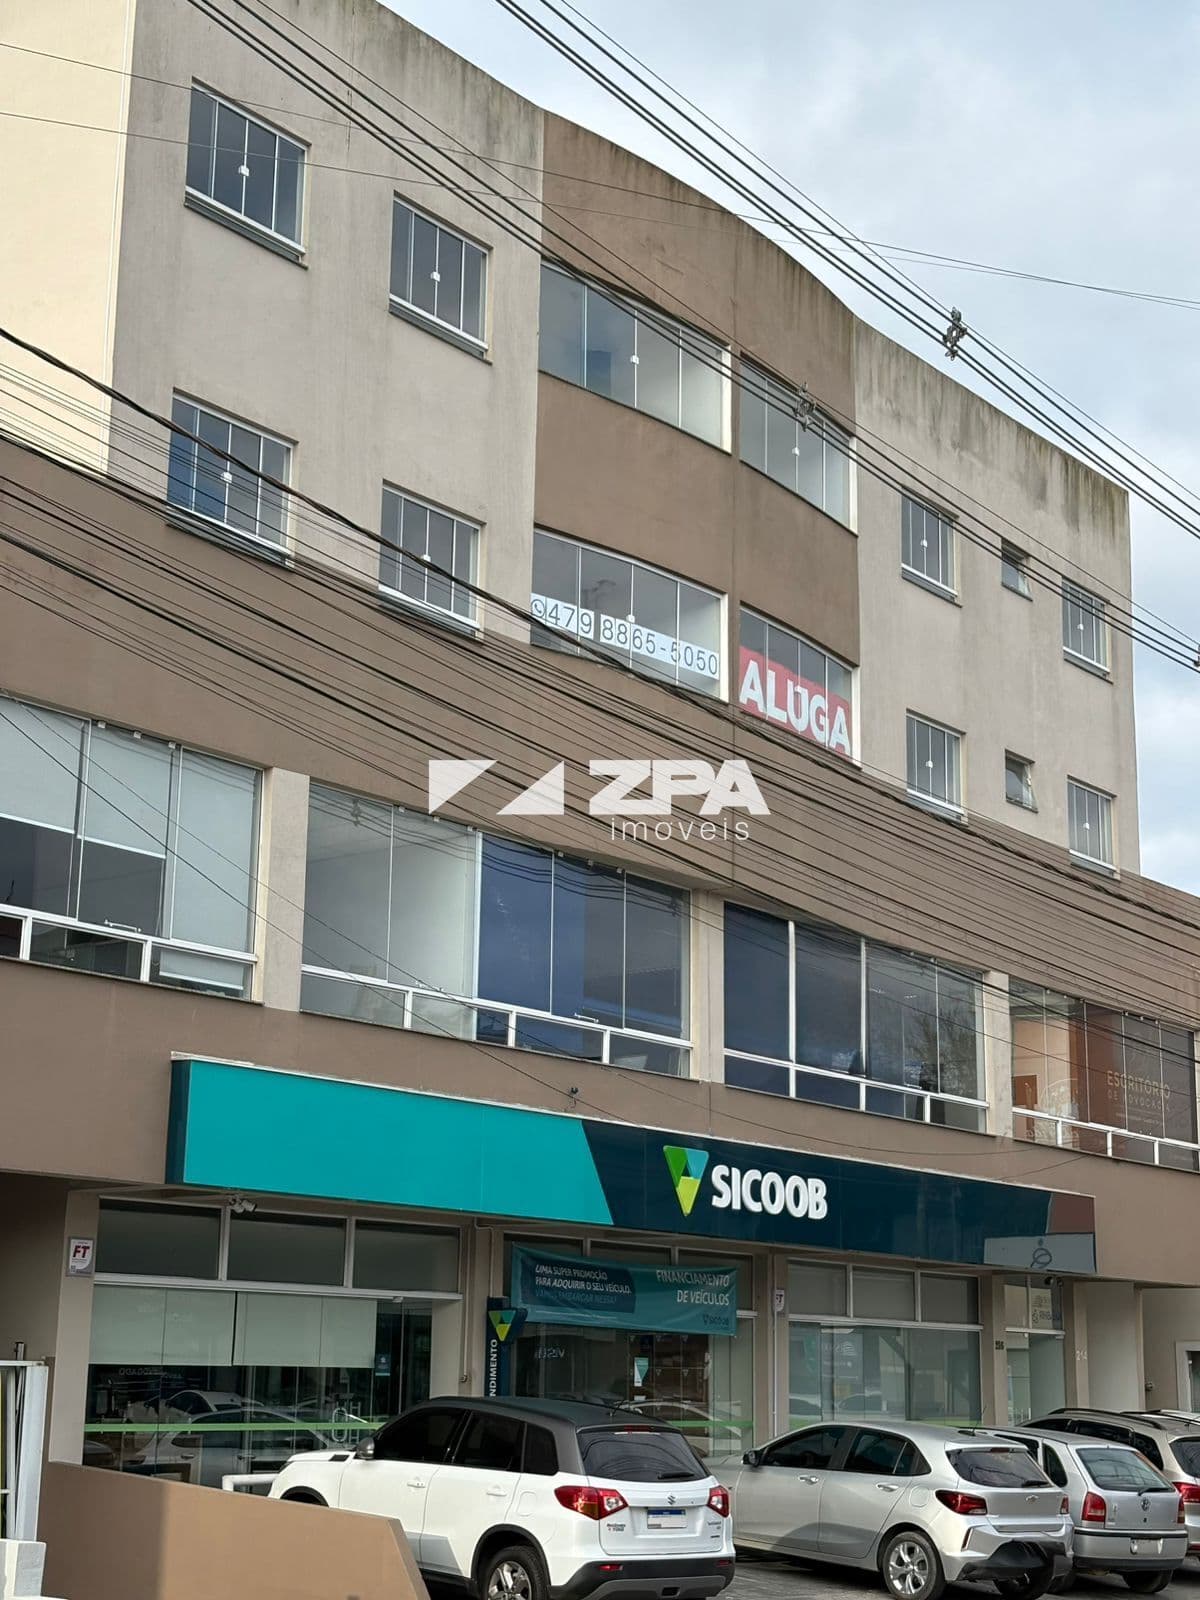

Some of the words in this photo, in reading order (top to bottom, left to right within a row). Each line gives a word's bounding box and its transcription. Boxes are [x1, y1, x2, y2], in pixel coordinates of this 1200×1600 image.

[602, 617, 718, 677] 8865-5050
[740, 659, 852, 756] ALUGA
[711, 1163, 829, 1221] SICOOB
[72, 1244, 91, 1259] FT
[535, 1276, 552, 1287] PARA
[551, 1278, 586, 1290] ADQUIRIR
[586, 1281, 592, 1290] O
[592, 1282, 605, 1292] SEU
[656, 1269, 730, 1287] FINANCIAMENTO
[676, 1289, 689, 1303] DE
[690, 1288, 730, 1306] VEÍCULOS
